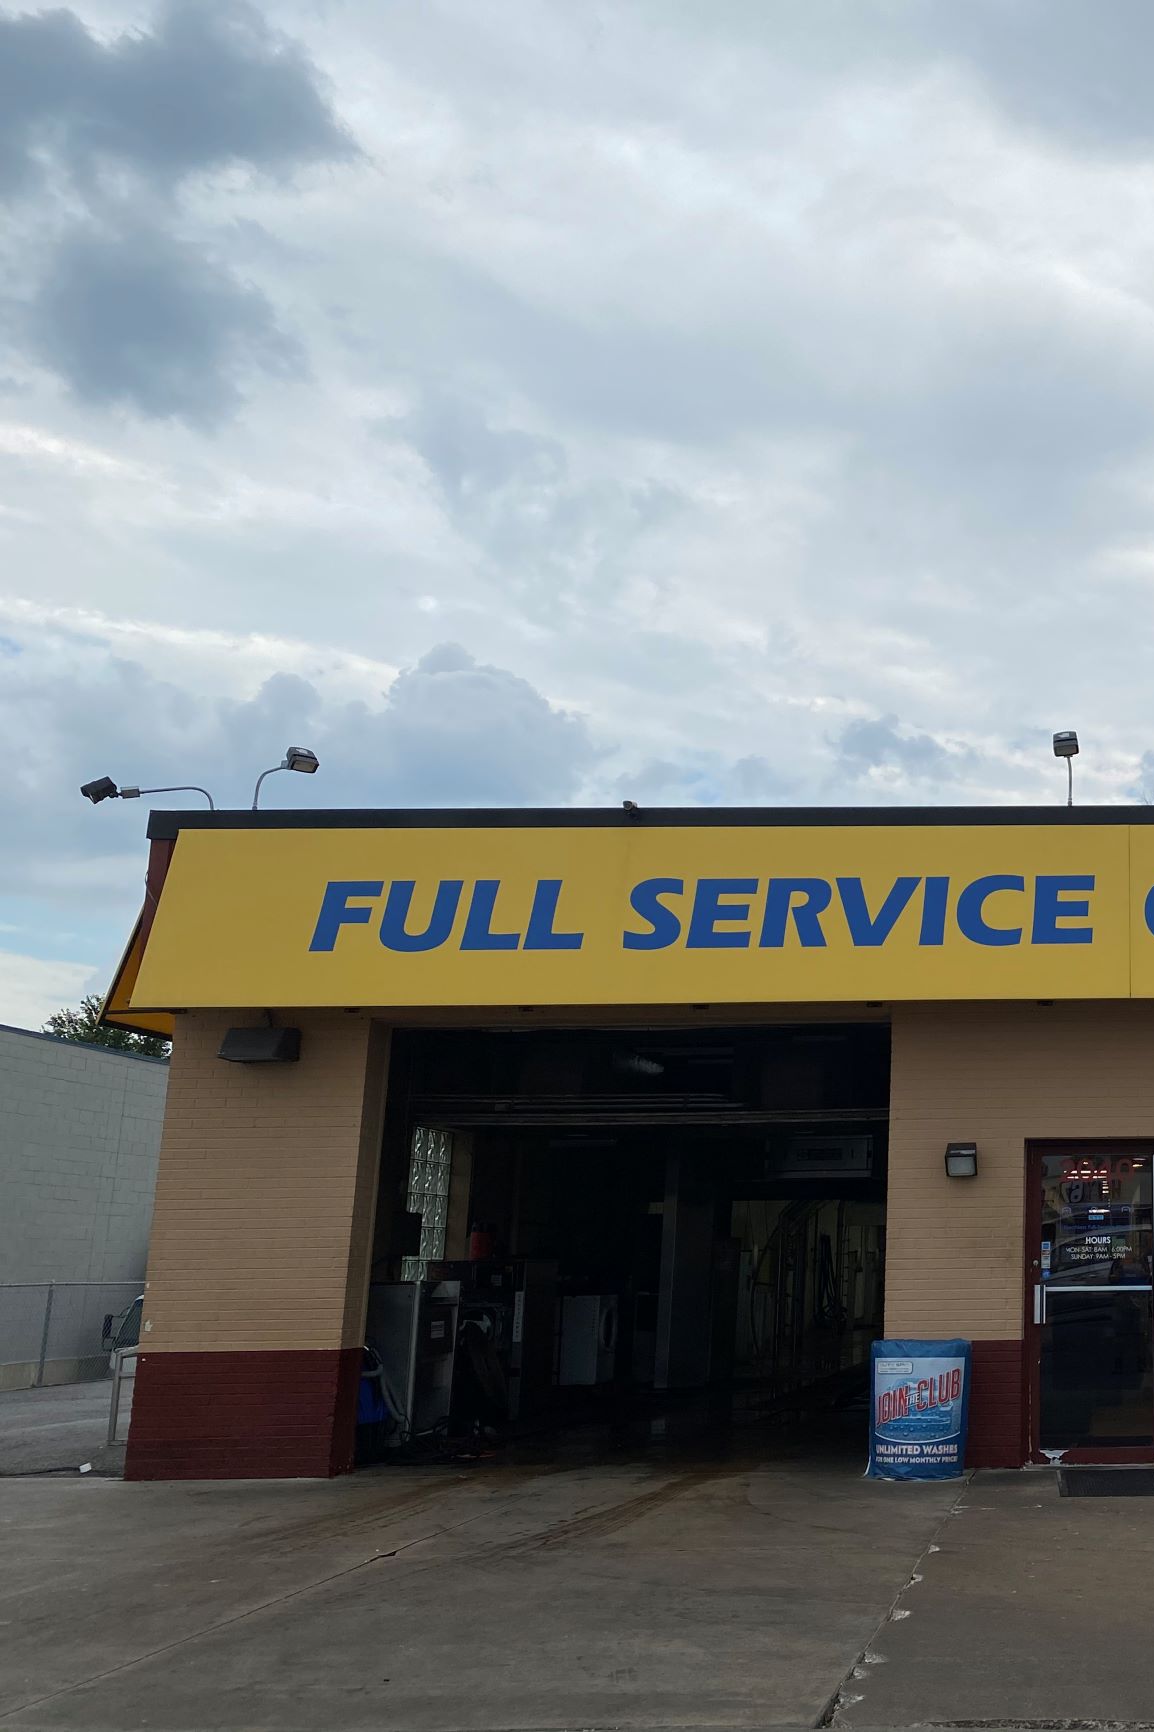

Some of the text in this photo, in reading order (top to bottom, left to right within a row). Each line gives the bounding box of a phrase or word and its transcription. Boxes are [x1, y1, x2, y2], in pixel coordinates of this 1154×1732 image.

[308, 879, 585, 952] FULL
[622, 873, 1096, 951] SERVICE
[1084, 1236, 1111, 1246] HOURS
[876, 1367, 960, 1428] JOIN THE CLUB
[876, 1444, 958, 1454] UNLIMITED WASHES
